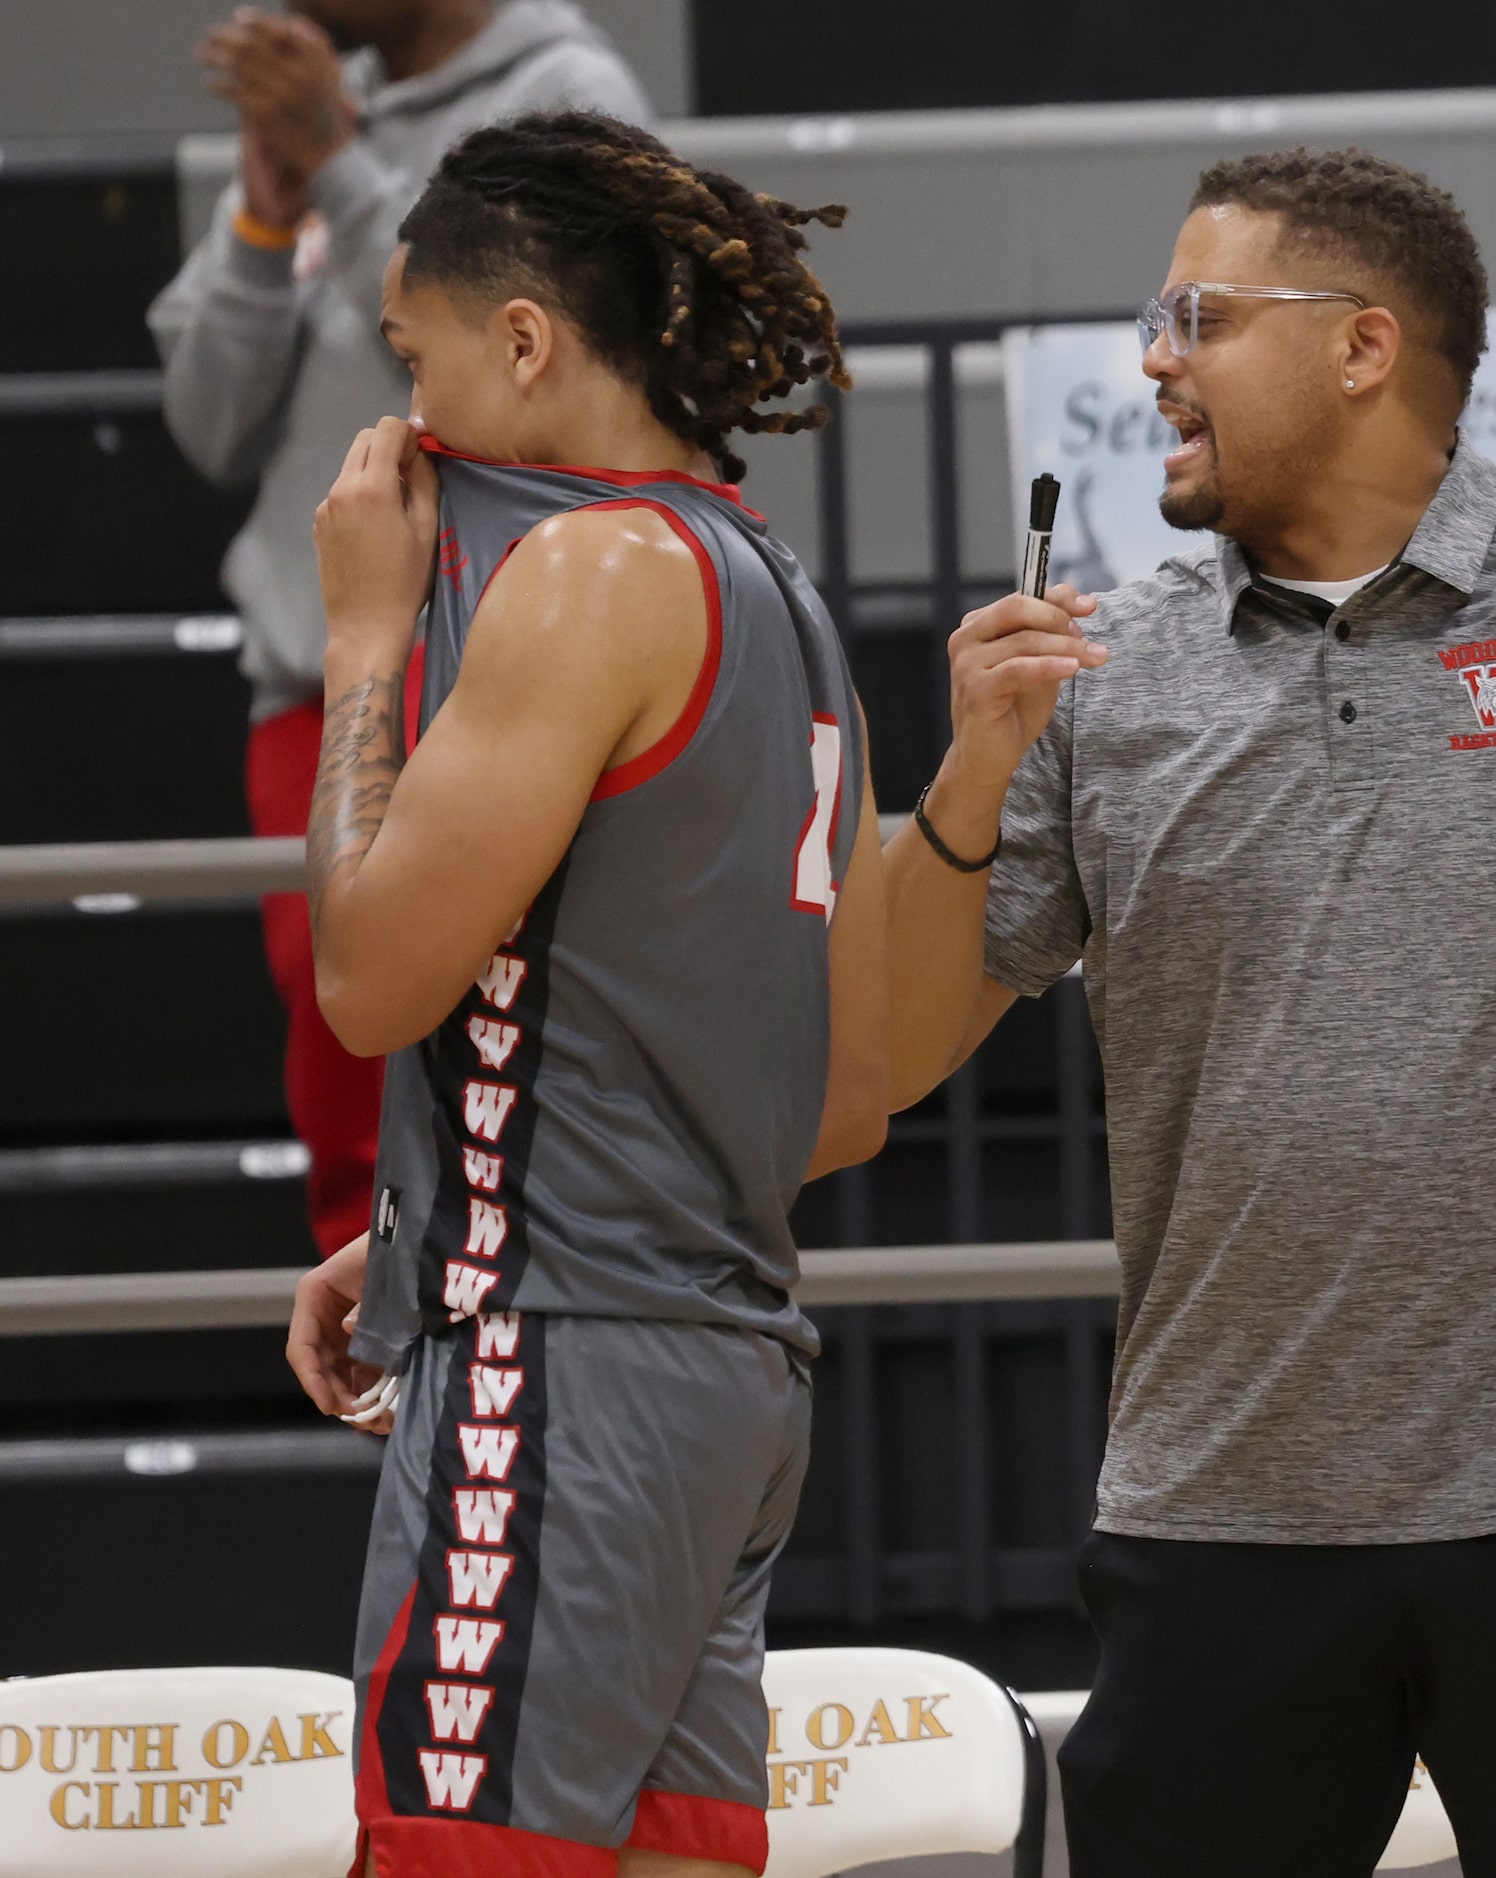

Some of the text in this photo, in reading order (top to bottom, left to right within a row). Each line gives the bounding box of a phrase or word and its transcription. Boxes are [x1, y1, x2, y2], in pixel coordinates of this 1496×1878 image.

[465, 1012, 522, 1072] W
[463, 1076, 518, 1144] W
[463, 1194, 509, 1260] W
[442, 1259, 501, 1324] W
[475, 1310, 524, 1361] W
[457, 1423, 521, 1482] W
[451, 1486, 517, 1546] W
[445, 1548, 515, 1610] W
[432, 1613, 506, 1676] W
[0, 1711, 344, 1773] OUTH OAK
[424, 1680, 495, 1745] W
[805, 1693, 953, 1751] OAK
[49, 1776, 242, 1830] CLIFF
[417, 1748, 488, 1812] W
